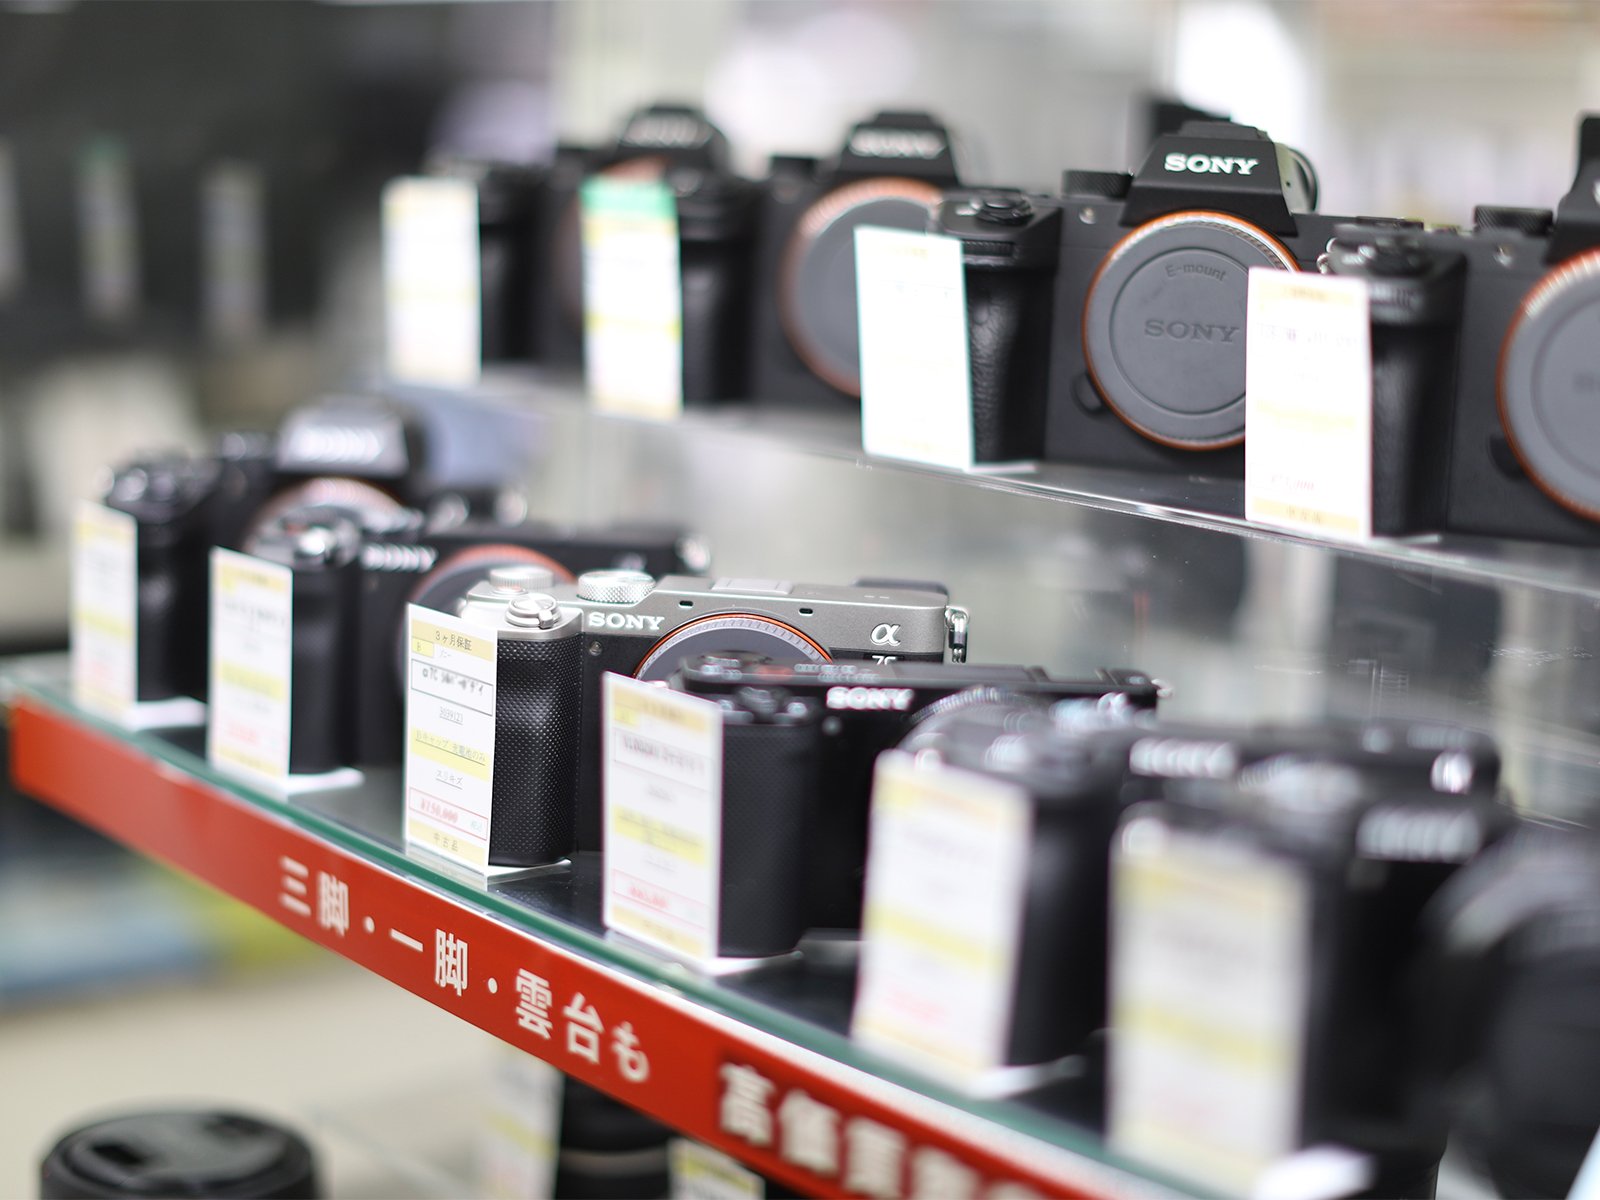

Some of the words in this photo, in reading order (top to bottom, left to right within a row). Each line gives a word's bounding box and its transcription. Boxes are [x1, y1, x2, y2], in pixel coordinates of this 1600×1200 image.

[1164, 152, 1259, 176] SONY
[1166, 261, 1228, 282] E-mount
[1143, 317, 1241, 344] SONY
[588, 611, 665, 632] SONY
[826, 686, 915, 711] SONY
